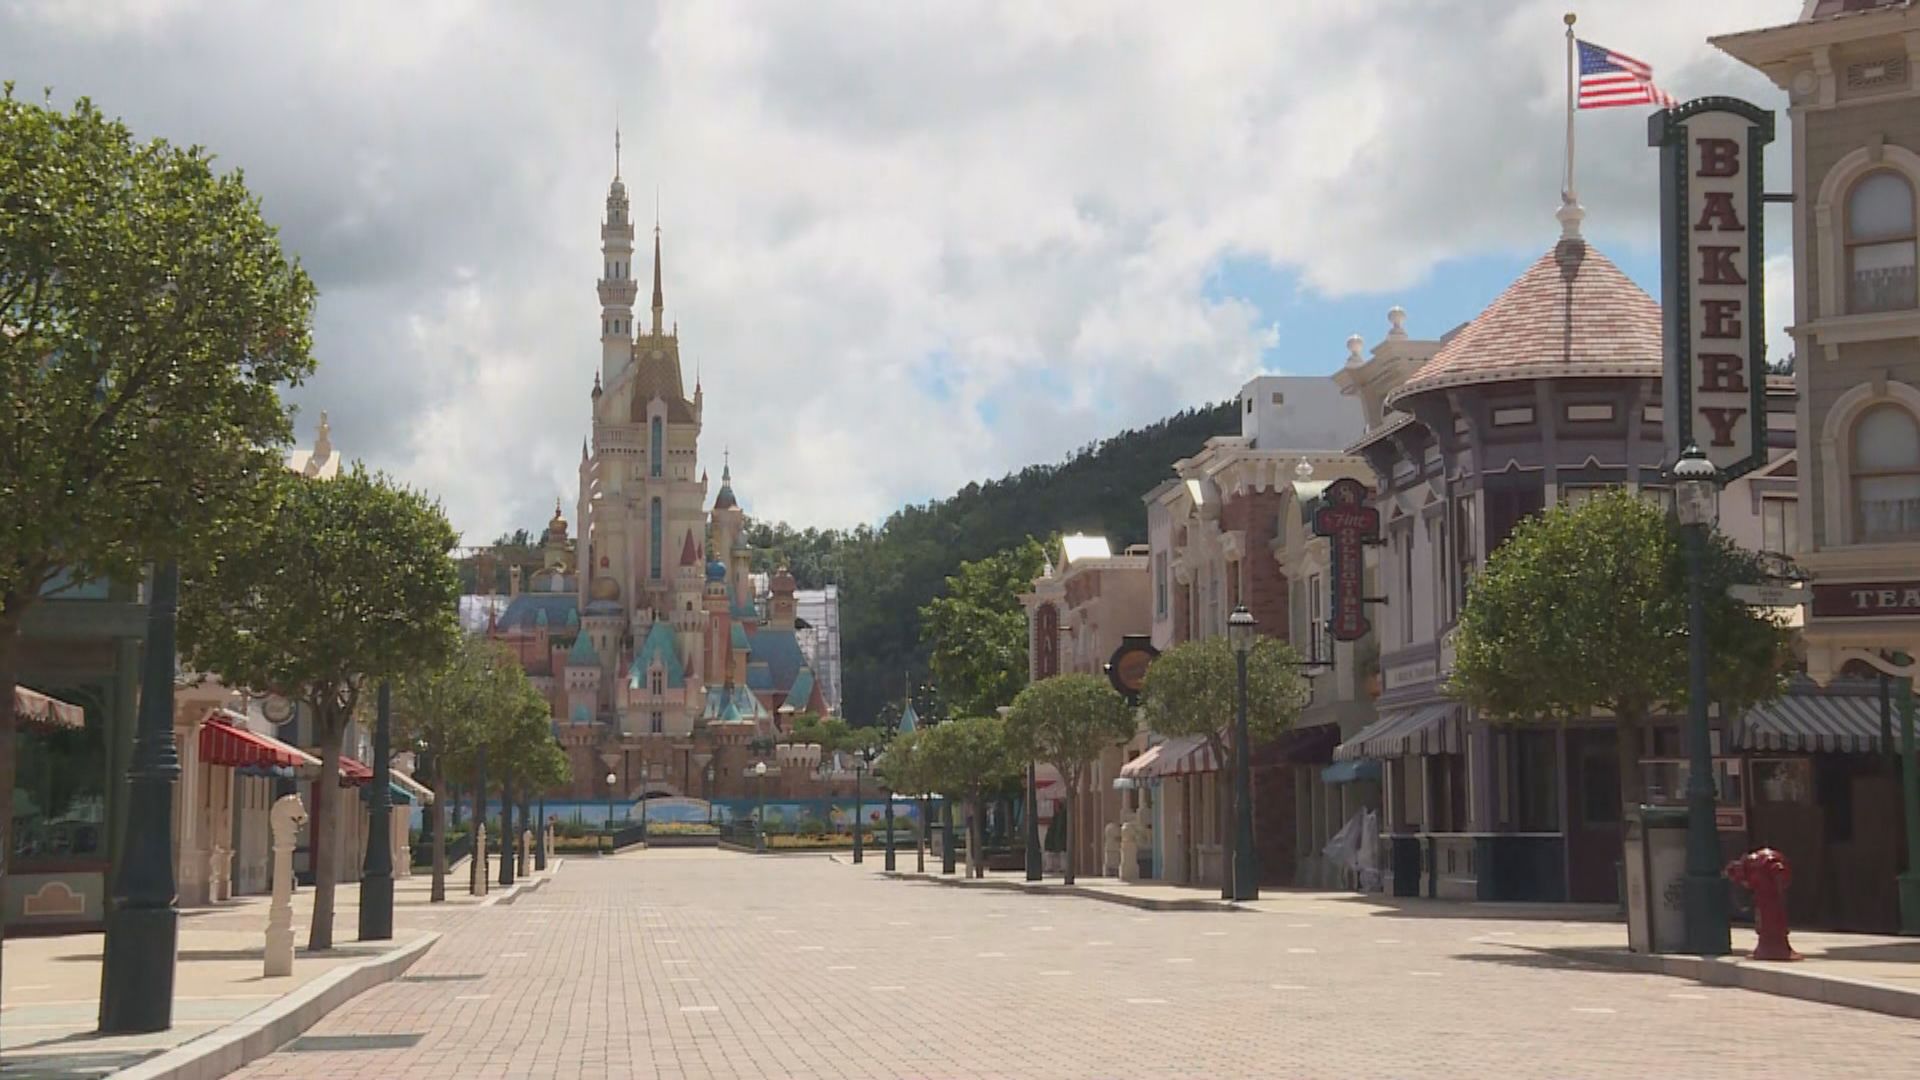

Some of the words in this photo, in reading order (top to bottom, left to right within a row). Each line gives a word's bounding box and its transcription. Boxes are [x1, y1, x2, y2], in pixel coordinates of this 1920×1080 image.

[1694, 137, 1748, 448] BAKERY
[1335, 511, 1366, 528] Fine
[1851, 589, 1920, 609] TEA
